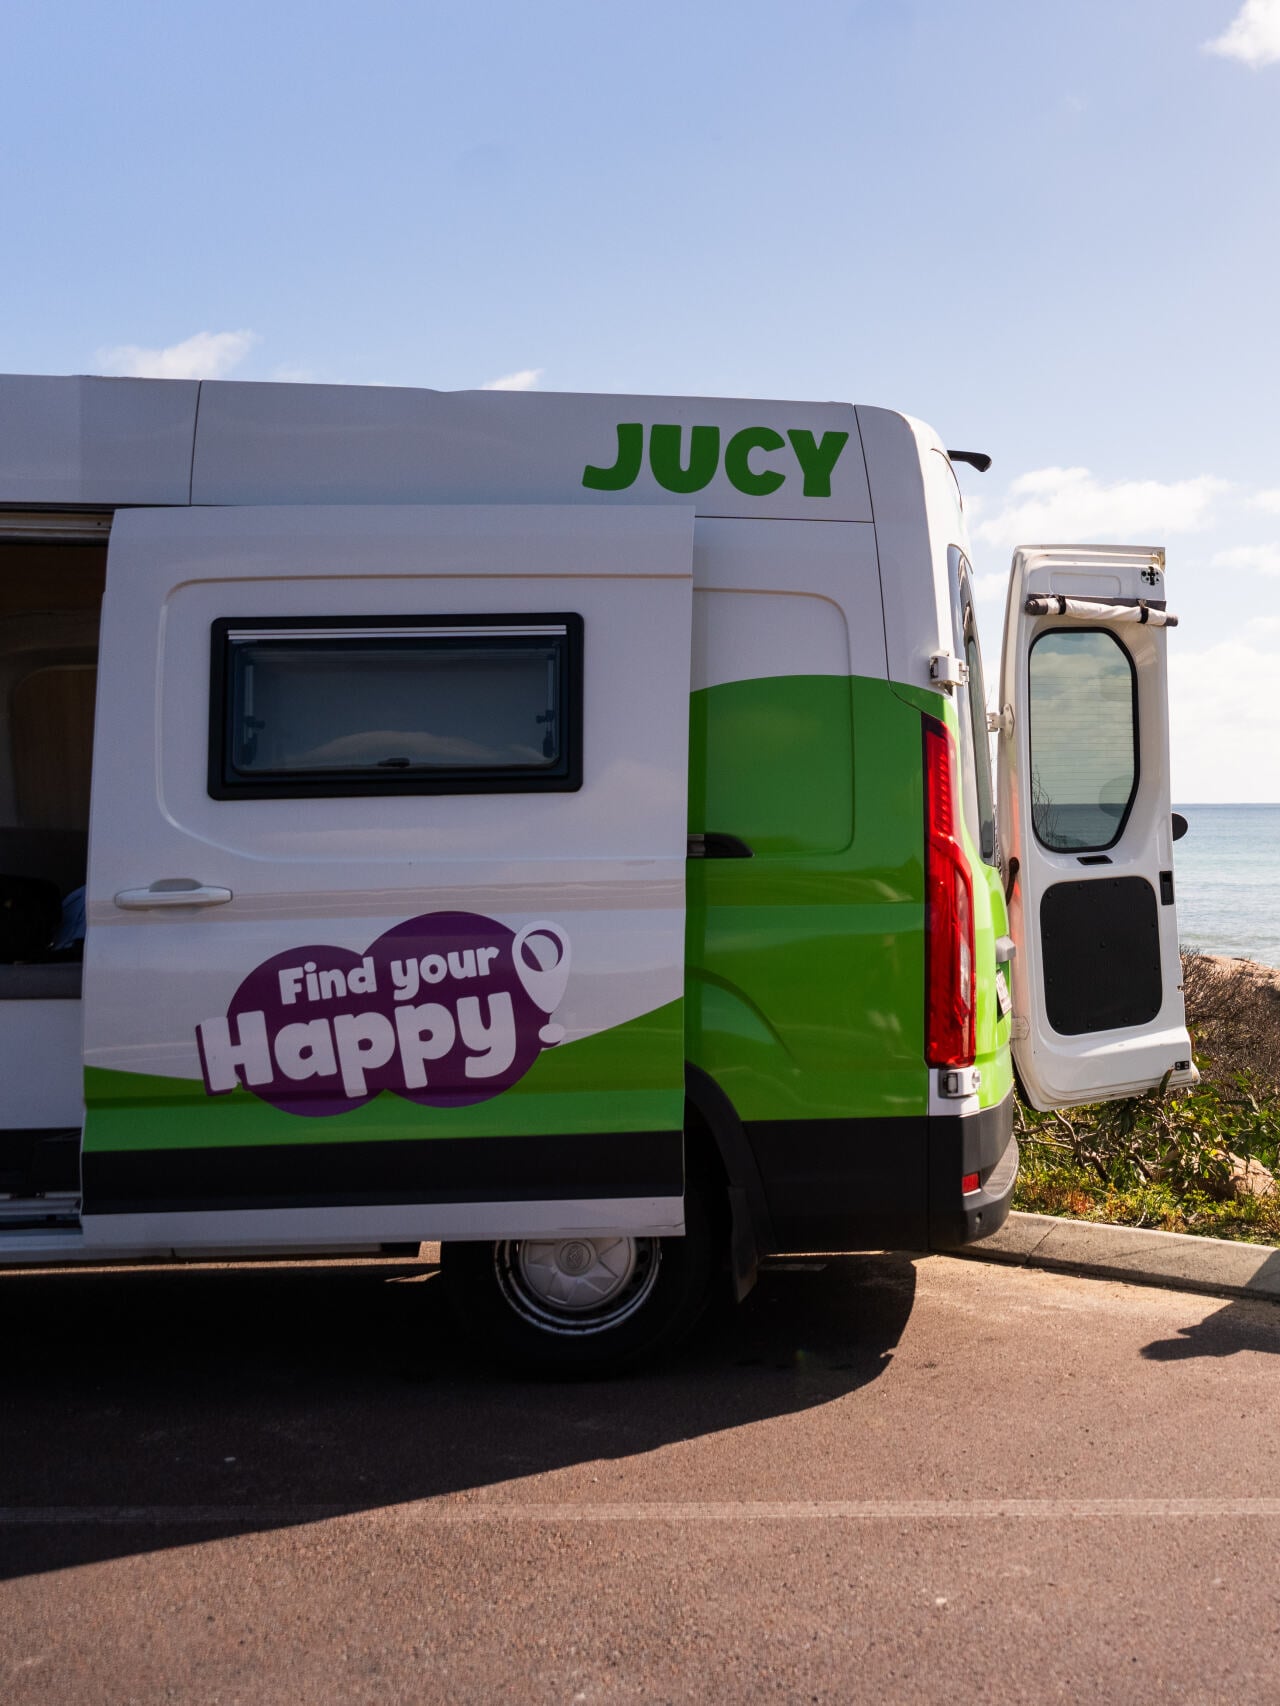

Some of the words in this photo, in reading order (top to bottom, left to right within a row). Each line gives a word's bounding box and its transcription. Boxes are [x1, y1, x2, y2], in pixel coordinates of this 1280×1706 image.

[582, 423, 849, 497] JUCY
[278, 957, 377, 1005] Find
[391, 946, 499, 1000] your
